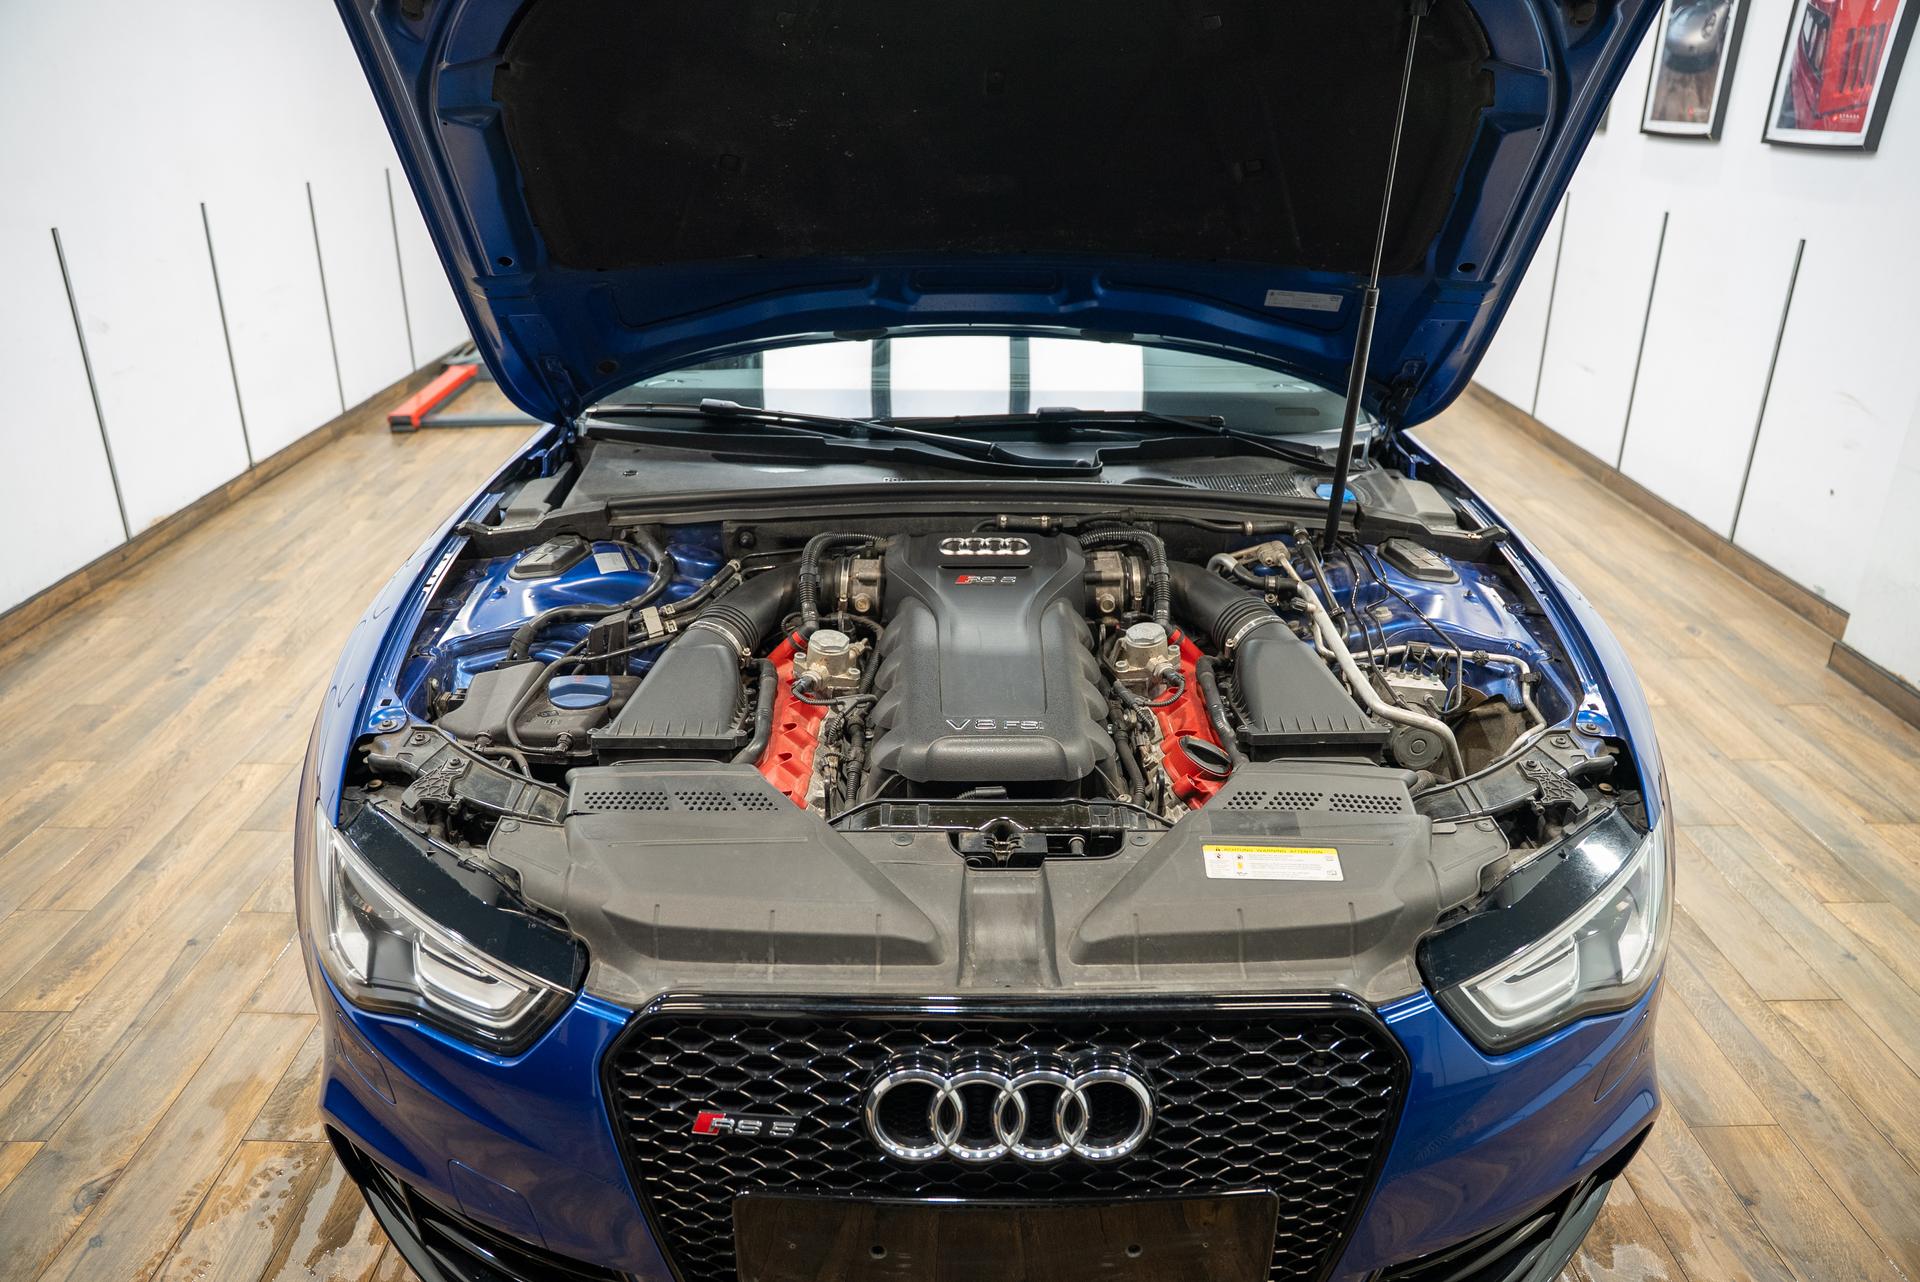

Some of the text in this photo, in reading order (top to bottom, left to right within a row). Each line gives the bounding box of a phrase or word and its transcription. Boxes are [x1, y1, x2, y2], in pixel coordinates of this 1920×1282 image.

[965, 575, 997, 584] RS
[946, 719, 997, 730] V8
[710, 1118, 797, 1136] RS 5
